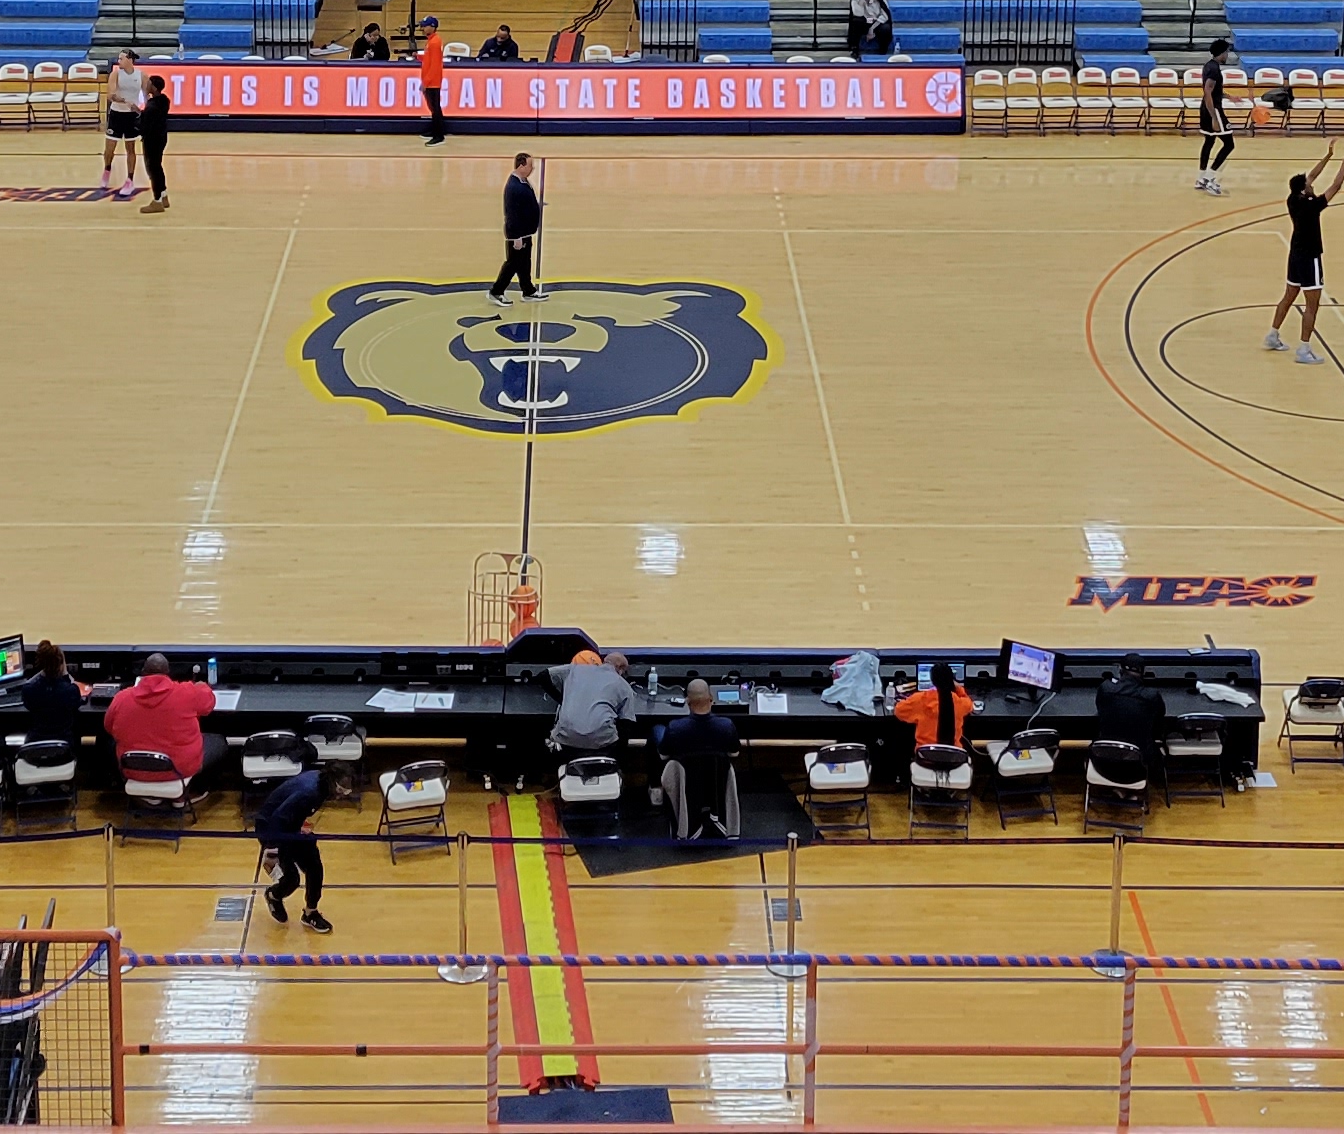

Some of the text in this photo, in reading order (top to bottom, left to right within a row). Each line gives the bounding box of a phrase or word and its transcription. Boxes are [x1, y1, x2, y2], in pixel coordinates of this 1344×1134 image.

[170, 75, 258, 107] THIS
[284, 75, 319, 108] IS
[529, 77, 641, 110] STATE
[667, 77, 907, 109] BASKETBALL
[1066, 574, 1318, 614] MEAC
